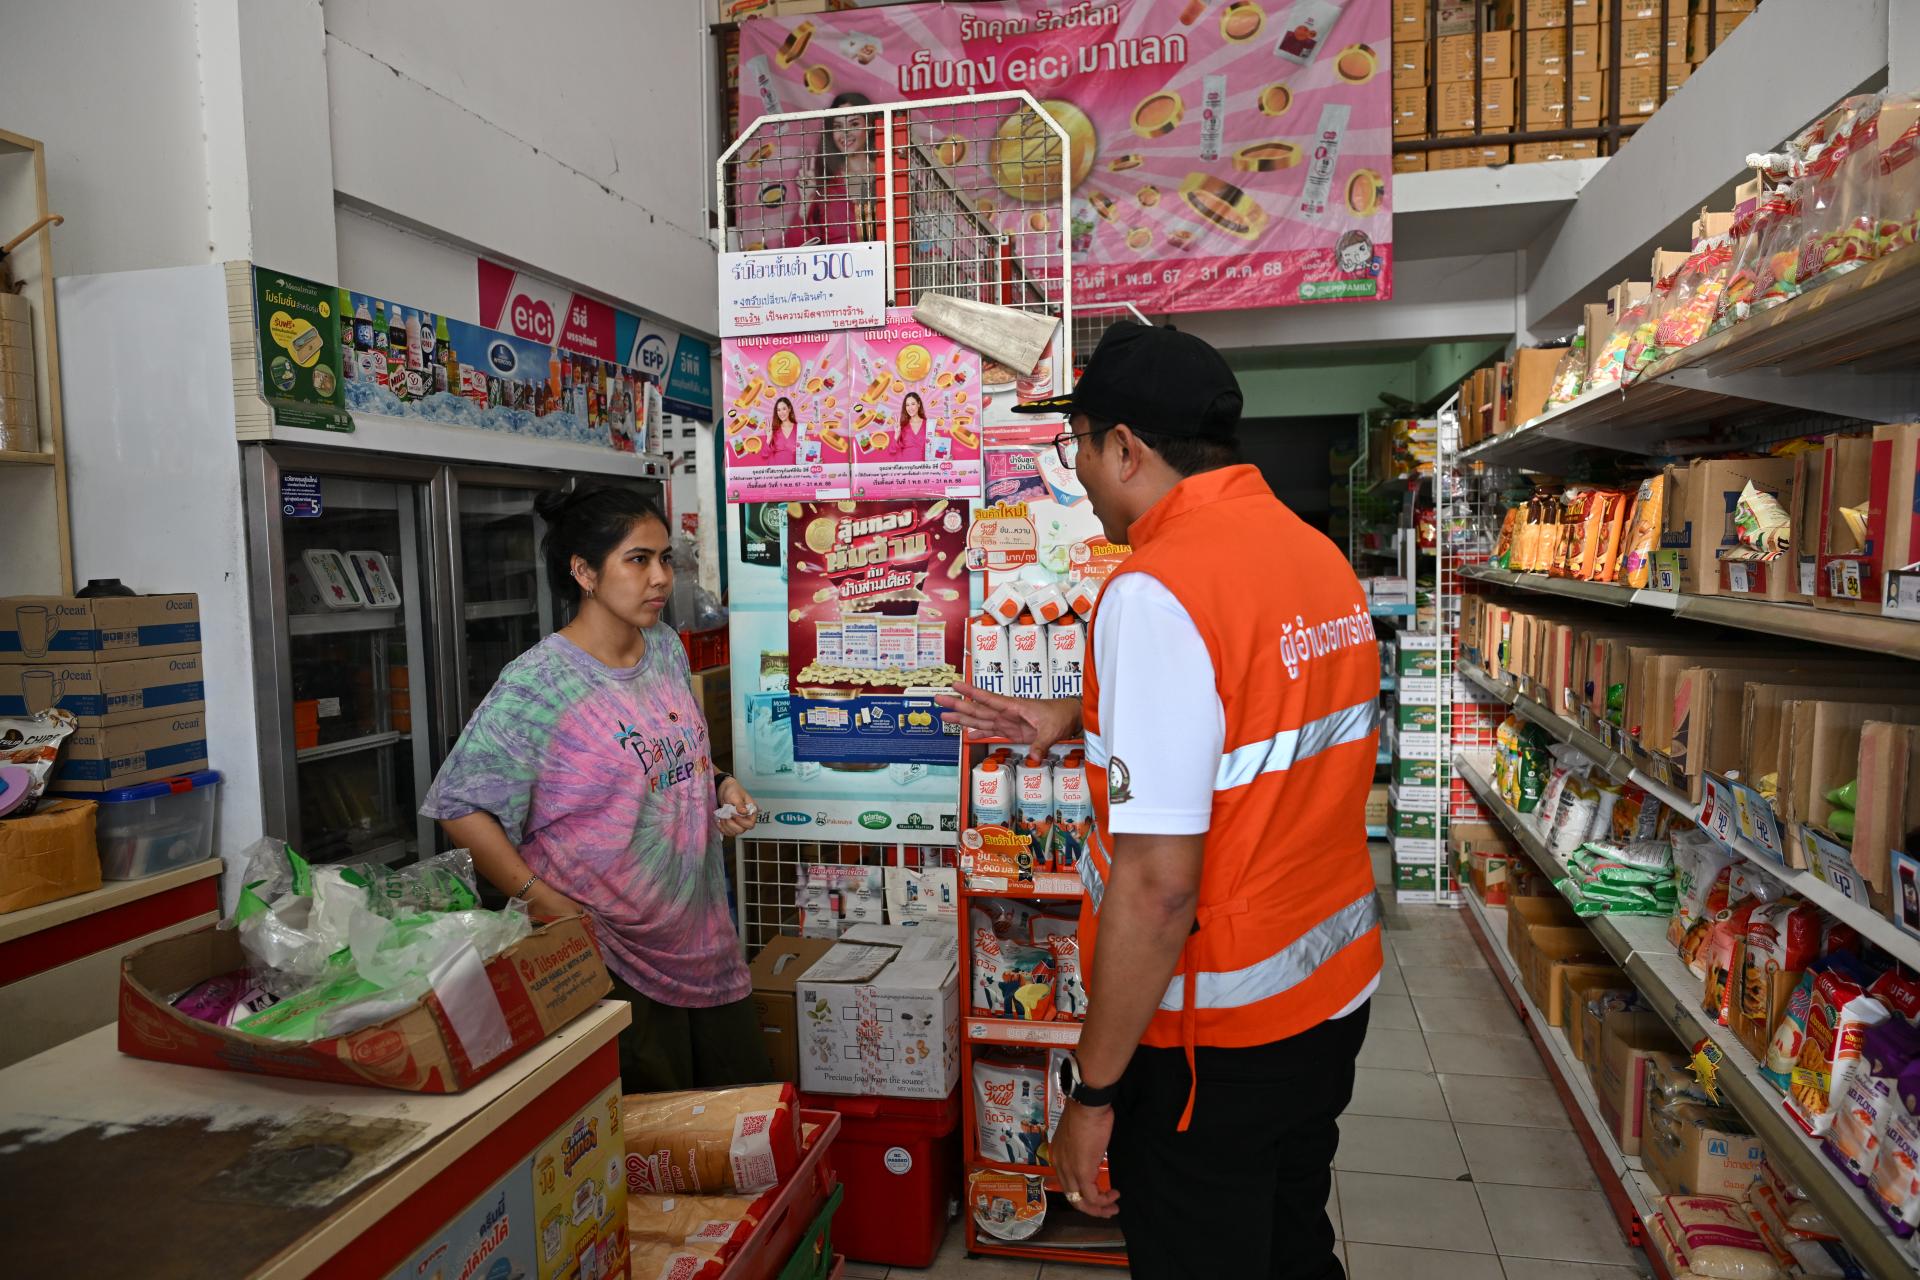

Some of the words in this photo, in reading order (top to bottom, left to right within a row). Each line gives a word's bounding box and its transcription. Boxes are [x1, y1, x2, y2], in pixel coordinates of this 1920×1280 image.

[961, 14, 1027, 43] รักคุณ
[900, 49, 997, 94] เก็บถุง
[1078, 33, 1187, 75] มาแลก
[812, 252, 854, 282] 500
[855, 269, 874, 278] บาท
[1074, 266, 1106, 289] วันที่
[1162, 269, 1182, 284] 67
[1201, 266, 1219, 281] 31
[1263, 261, 1282, 276] 68
[737, 336, 769, 349] เกบถุง
[642, 348, 664, 370] EPP
[311, 500, 319, 514] 5
[1006, 550, 1036, 562] บาท/ถุง
[867, 566, 884, 579] กับ
[55, 604, 87, 617] Ocean
[165, 599, 193, 611] Ocean
[976, 632, 998, 642] Good
[1014, 631, 1036, 642] Good
[1053, 631, 1076, 641] Good
[976, 640, 998, 651] Will
[1015, 640, 1036, 651] Will
[1054, 640, 1076, 650] Will
[169, 659, 197, 672] Ocean
[61, 669, 92, 682] Ocean
[975, 675, 1004, 692] UHT
[1013, 675, 1042, 693] UHT
[1052, 675, 1082, 693] UHT
[172, 718, 200, 731] Ocean
[979, 777, 998, 787] Good
[1023, 773, 1042, 782] Good
[1062, 773, 1081, 783] Good
[780, 813, 807, 823] Olivia
[1718, 811, 1728, 833] 42
[1756, 818, 1769, 843] 42
[1834, 871, 1852, 899] 42
[923, 889, 935, 897] VS
[976, 928, 996, 942] Goo
[824, 1072, 853, 1082] Precious
[853, 1074, 869, 1084] food
[871, 1075, 888, 1085] from
[889, 1075, 900, 1084] the
[984, 1080, 1015, 1092] Good
[984, 1090, 1015, 1107] Will
[1856, 1093, 1878, 1121] FLOUR
[1896, 1134, 1919, 1164] FLOUR
